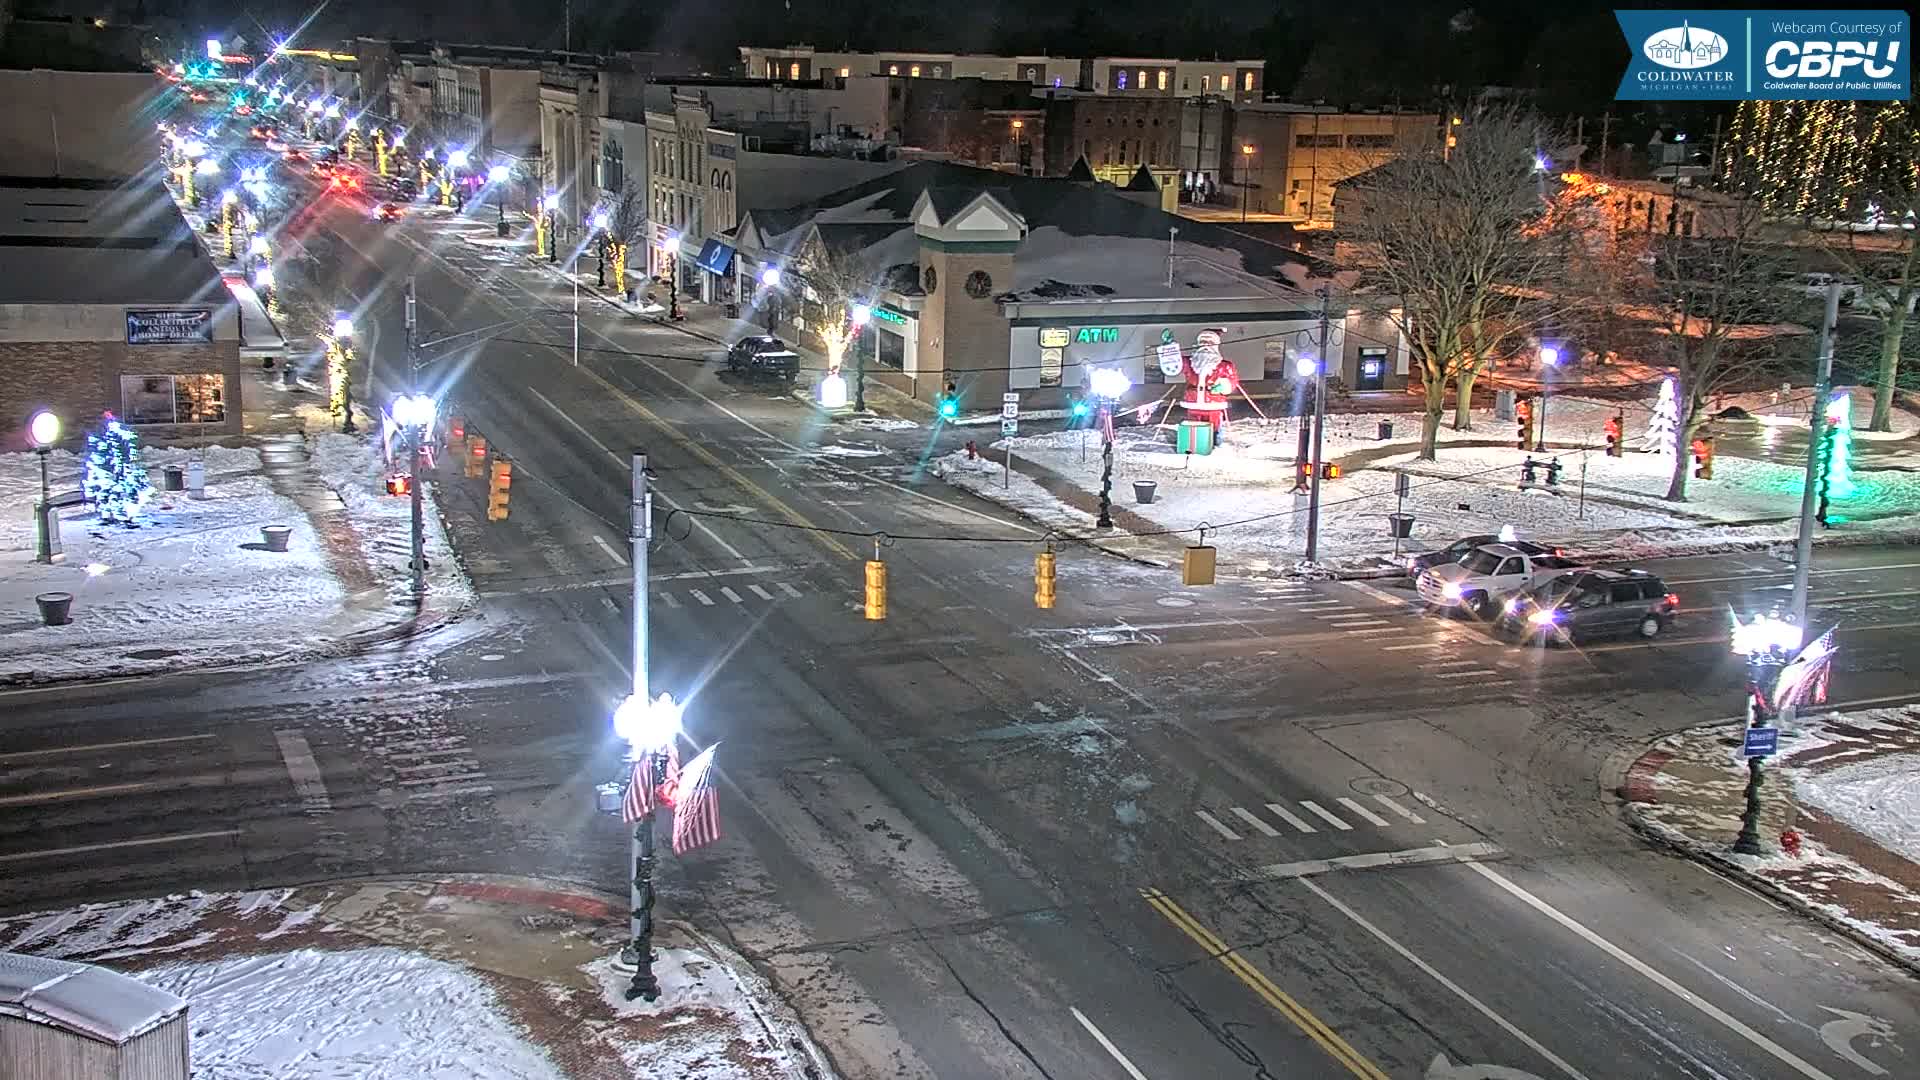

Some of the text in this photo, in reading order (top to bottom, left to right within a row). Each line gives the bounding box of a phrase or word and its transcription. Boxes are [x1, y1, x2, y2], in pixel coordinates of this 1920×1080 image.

[147, 325, 193, 333] ANTIQUES
[1075, 327, 1120, 343] ATM
[1006, 405, 1016, 415] 12
